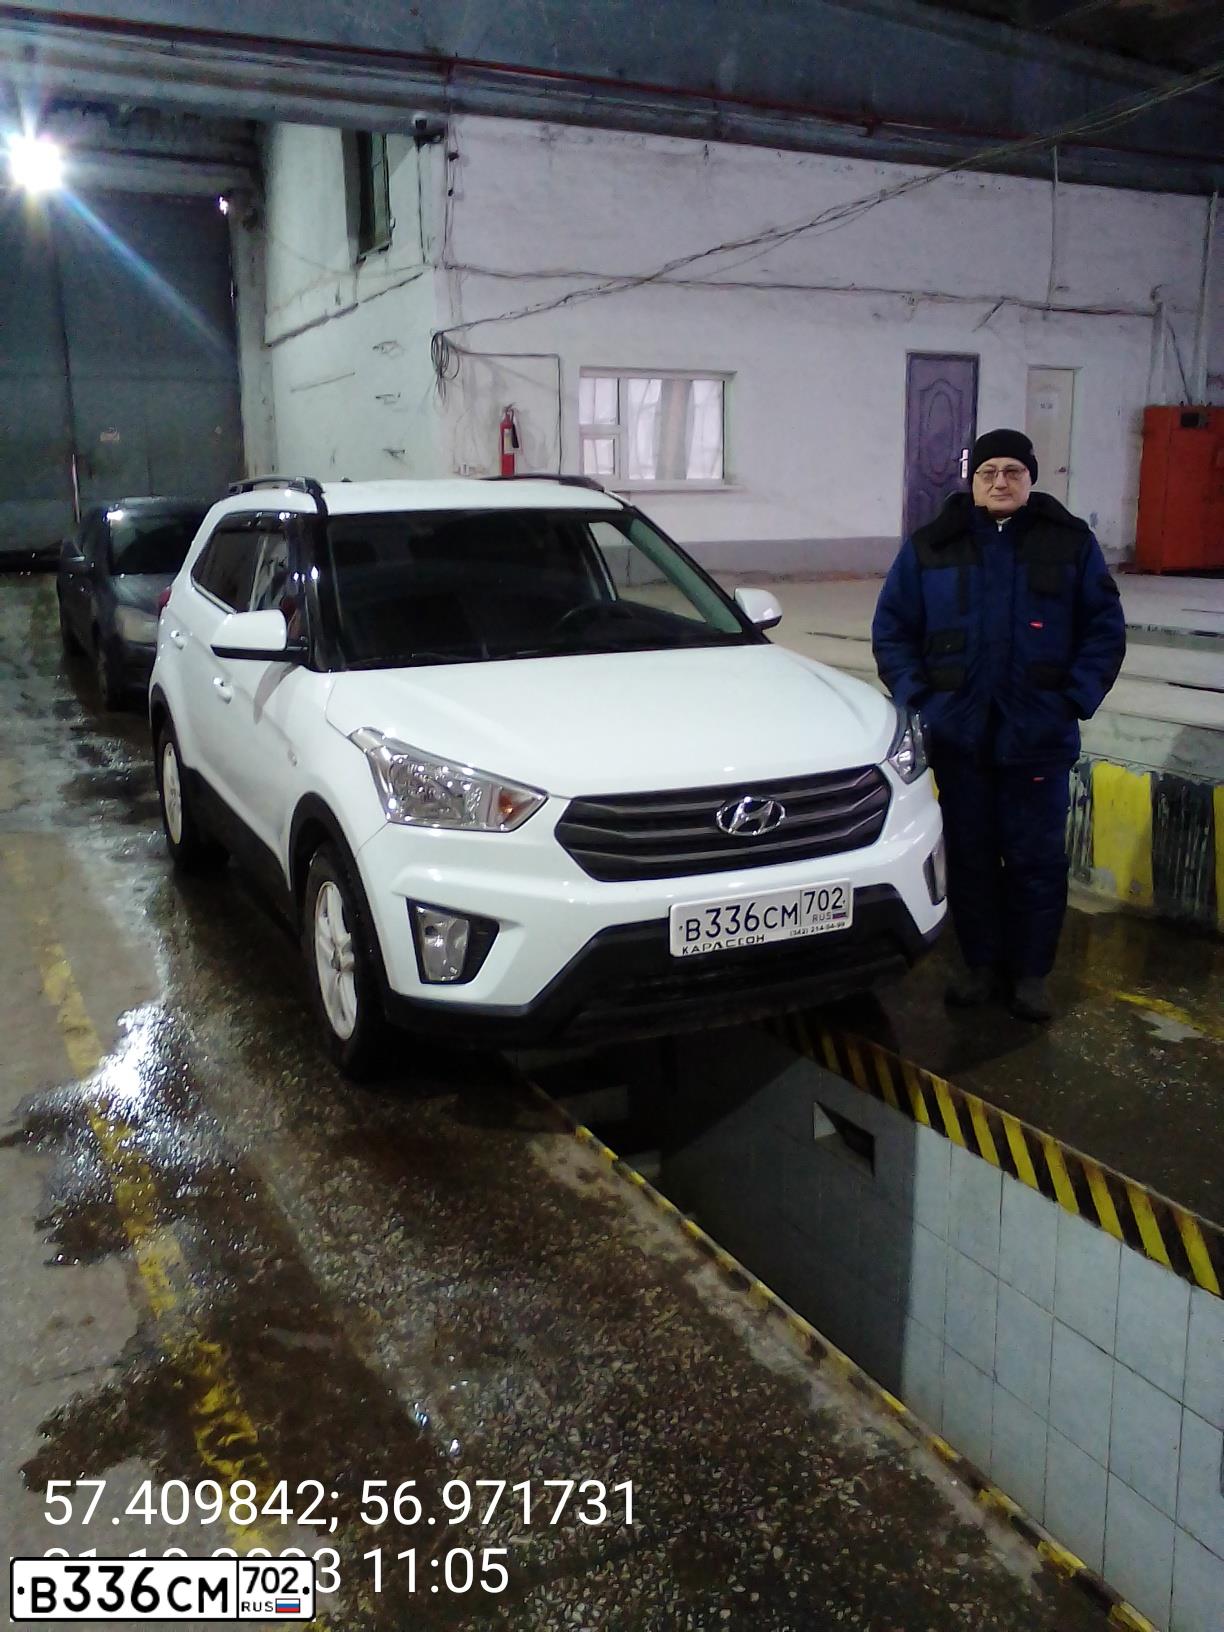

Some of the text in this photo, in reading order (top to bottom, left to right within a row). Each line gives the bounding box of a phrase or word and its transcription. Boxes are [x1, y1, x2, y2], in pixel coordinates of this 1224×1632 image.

[685, 887, 844, 942] В336СМ 702
[812, 912, 832, 923] RUS
